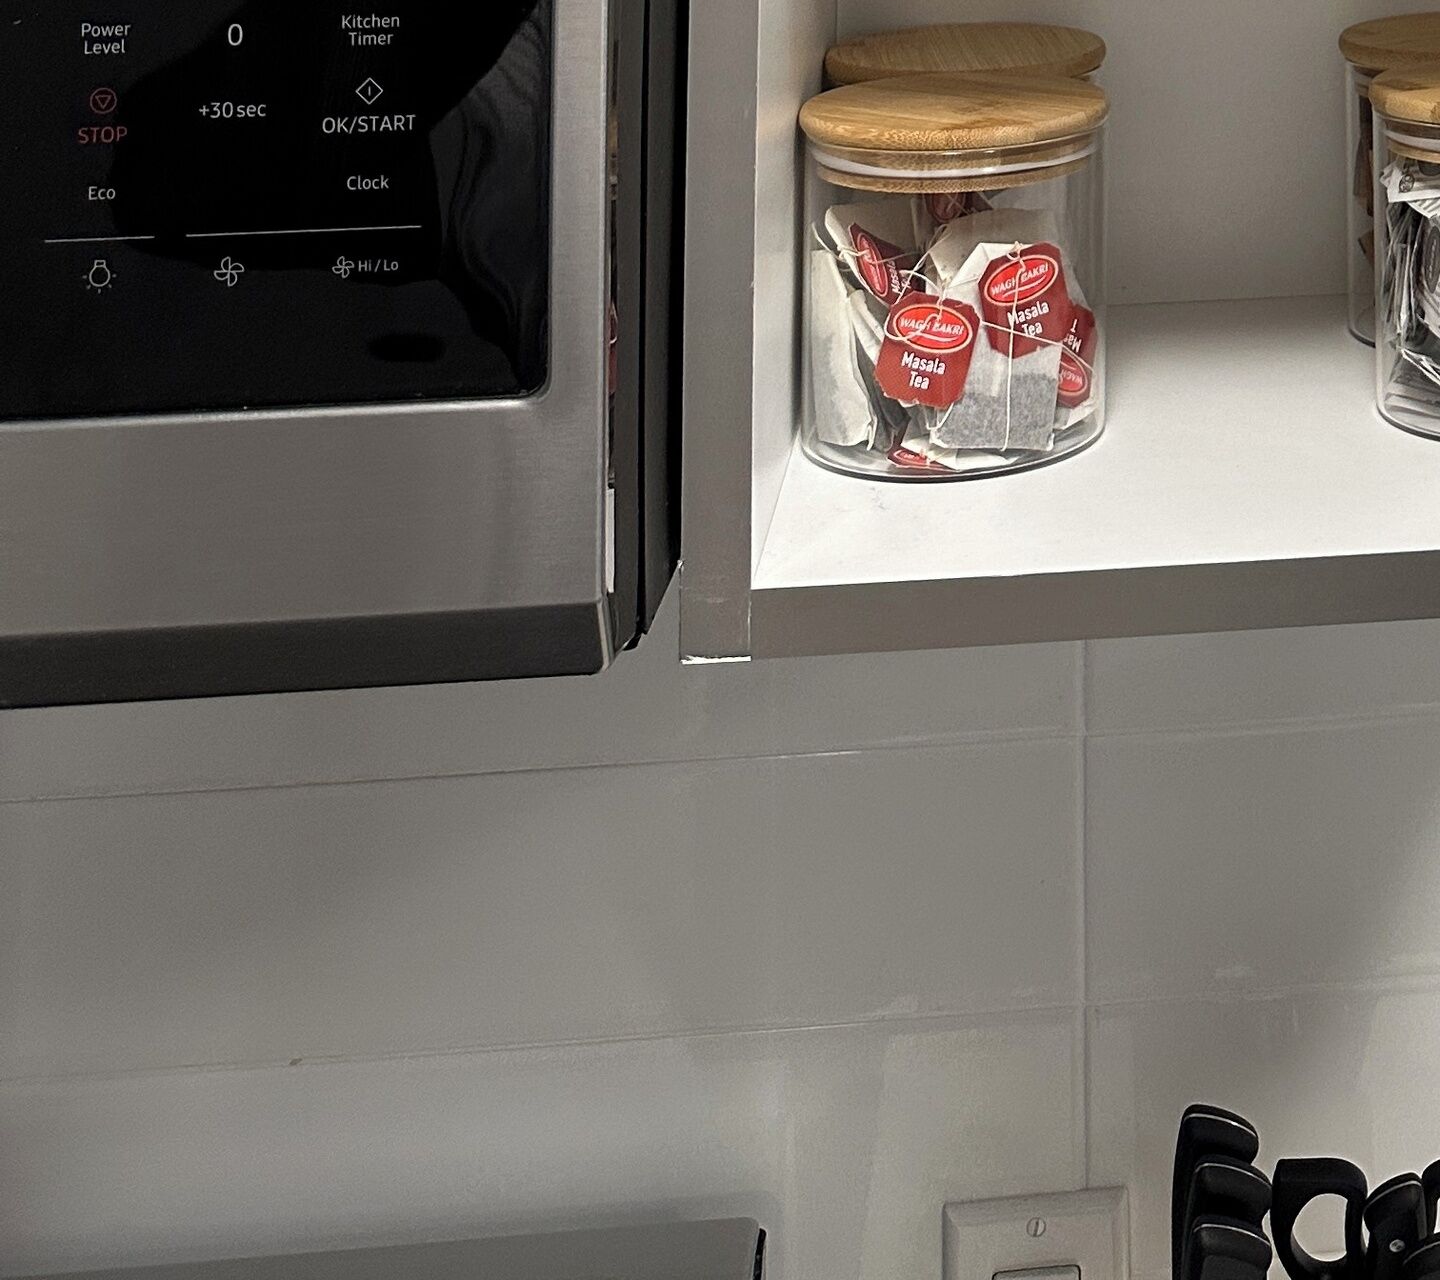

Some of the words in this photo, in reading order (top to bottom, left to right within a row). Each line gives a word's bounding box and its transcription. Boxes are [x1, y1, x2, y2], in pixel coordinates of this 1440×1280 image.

[341, 13, 400, 29] Kitchen
[81, 22, 131, 41] Power
[227, 23, 243, 46] 0
[348, 31, 394, 46] Timer
[84, 39, 126, 55] Level
[322, 114, 416, 134] OK/START
[78, 126, 128, 144] STOP
[346, 175, 389, 191] Clock
[88, 185, 116, 201] Eco
[1007, 300, 1050, 325] Masala
[1021, 321, 1043, 337] Tea
[901, 351, 946, 375] Masala
[909, 371, 930, 390] Tea
